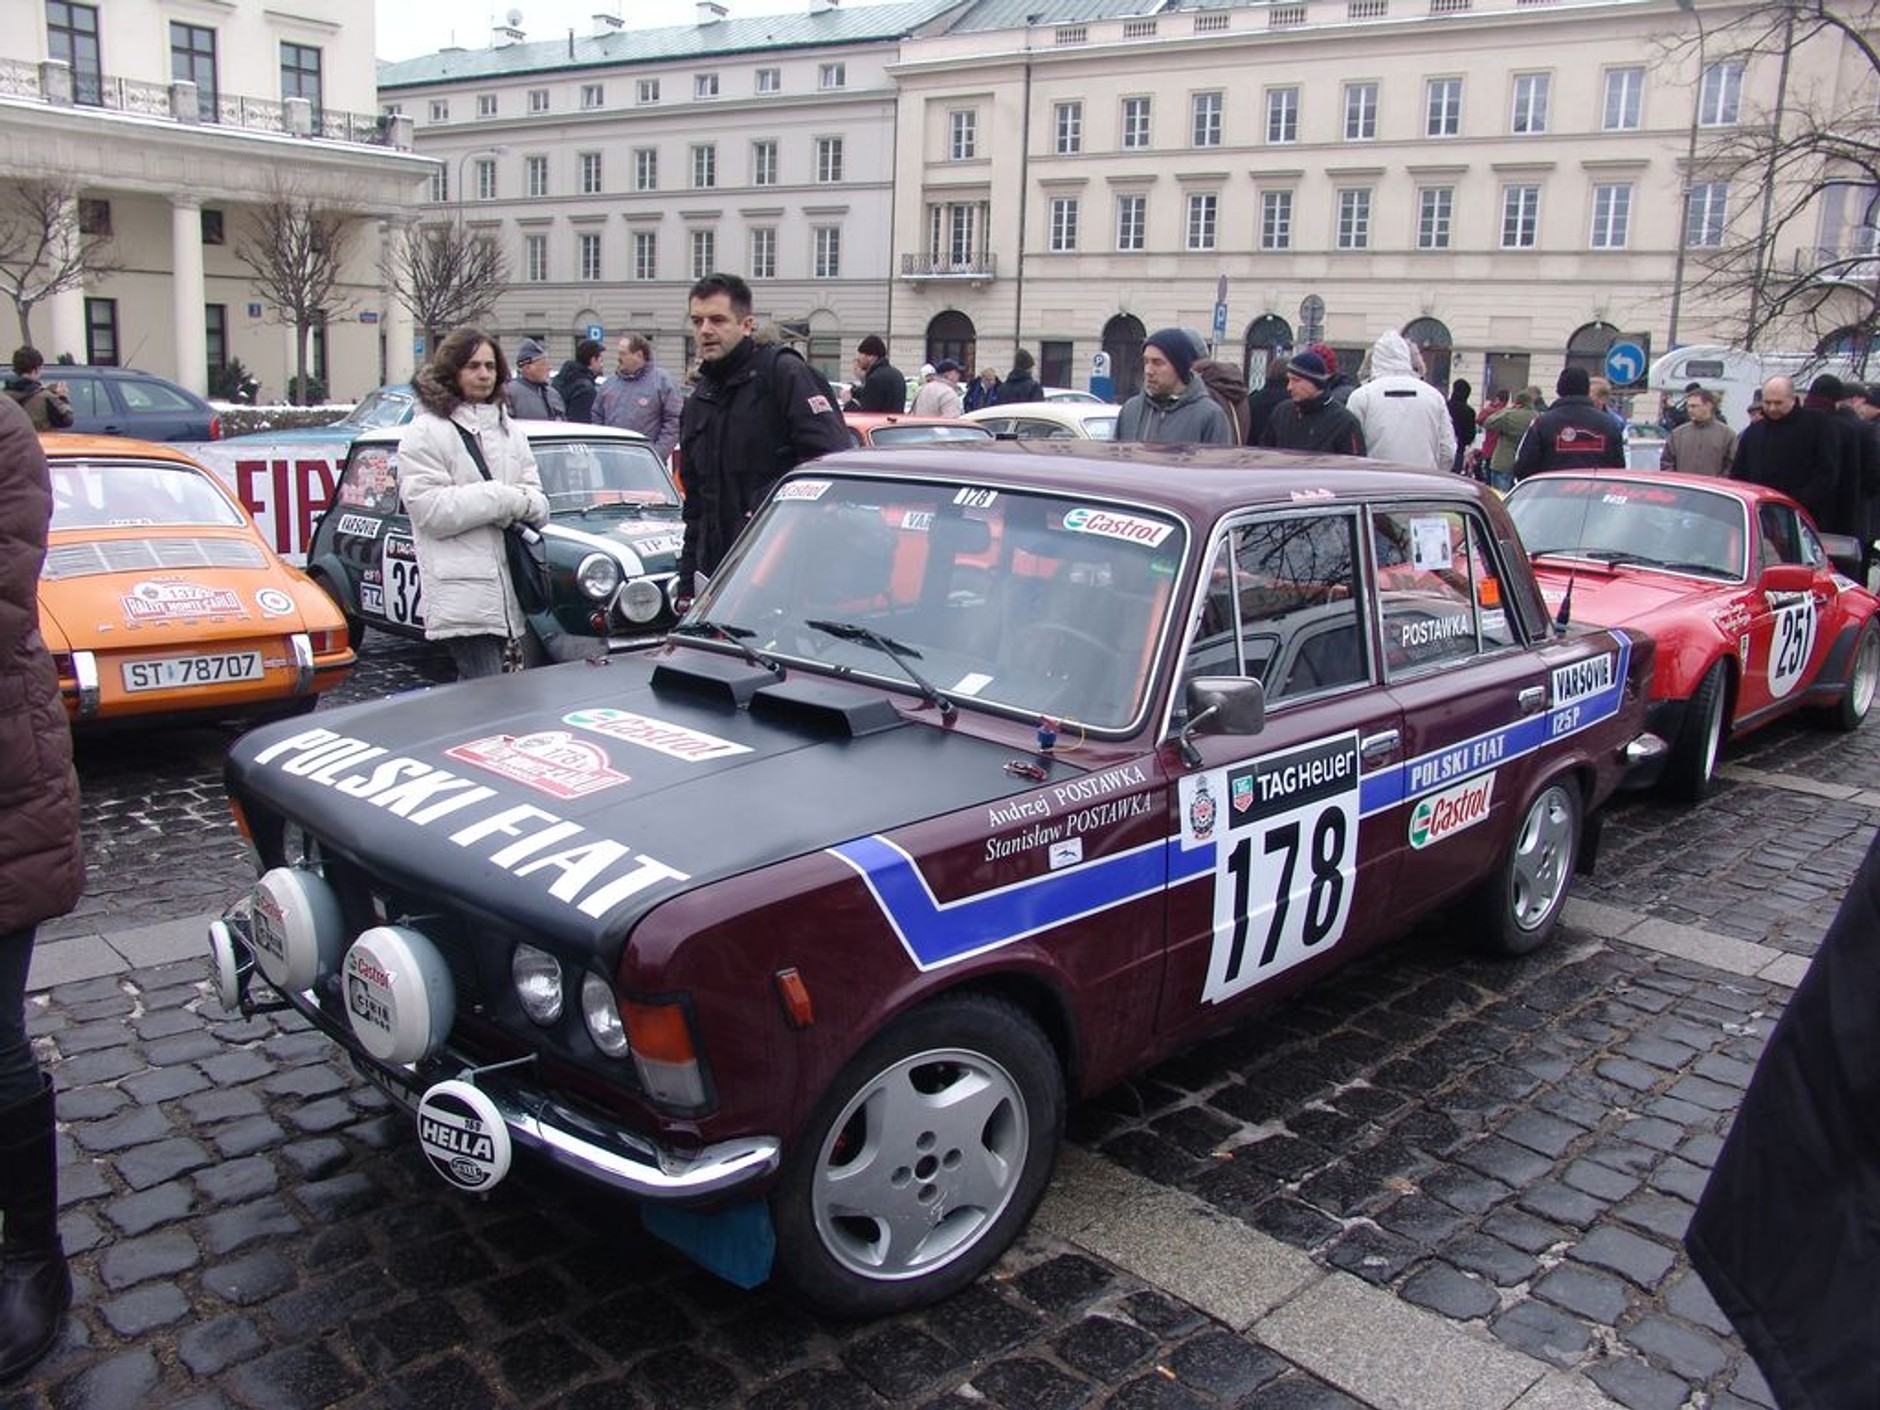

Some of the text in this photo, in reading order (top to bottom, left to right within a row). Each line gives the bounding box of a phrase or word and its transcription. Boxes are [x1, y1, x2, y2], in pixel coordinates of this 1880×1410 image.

[1086, 514, 1162, 542] Castrol
[1402, 614, 1468, 647] POSTAWKA
[1775, 605, 1812, 680] 251
[132, 662, 163, 687] ST
[178, 654, 255, 683] 78707
[1556, 656, 1608, 702] VARSOVIE
[1411, 734, 1505, 791] POLSKI FIAT
[989, 765, 1147, 828] Andrzej POSTAWKA
[1066, 791, 1152, 836] POSTAWKA
[1430, 778, 1490, 838] Castrol
[254, 728, 692, 920] POLSKI FIAT
[1225, 806, 1347, 984] 178
[422, 1119, 492, 1160] HELLA
